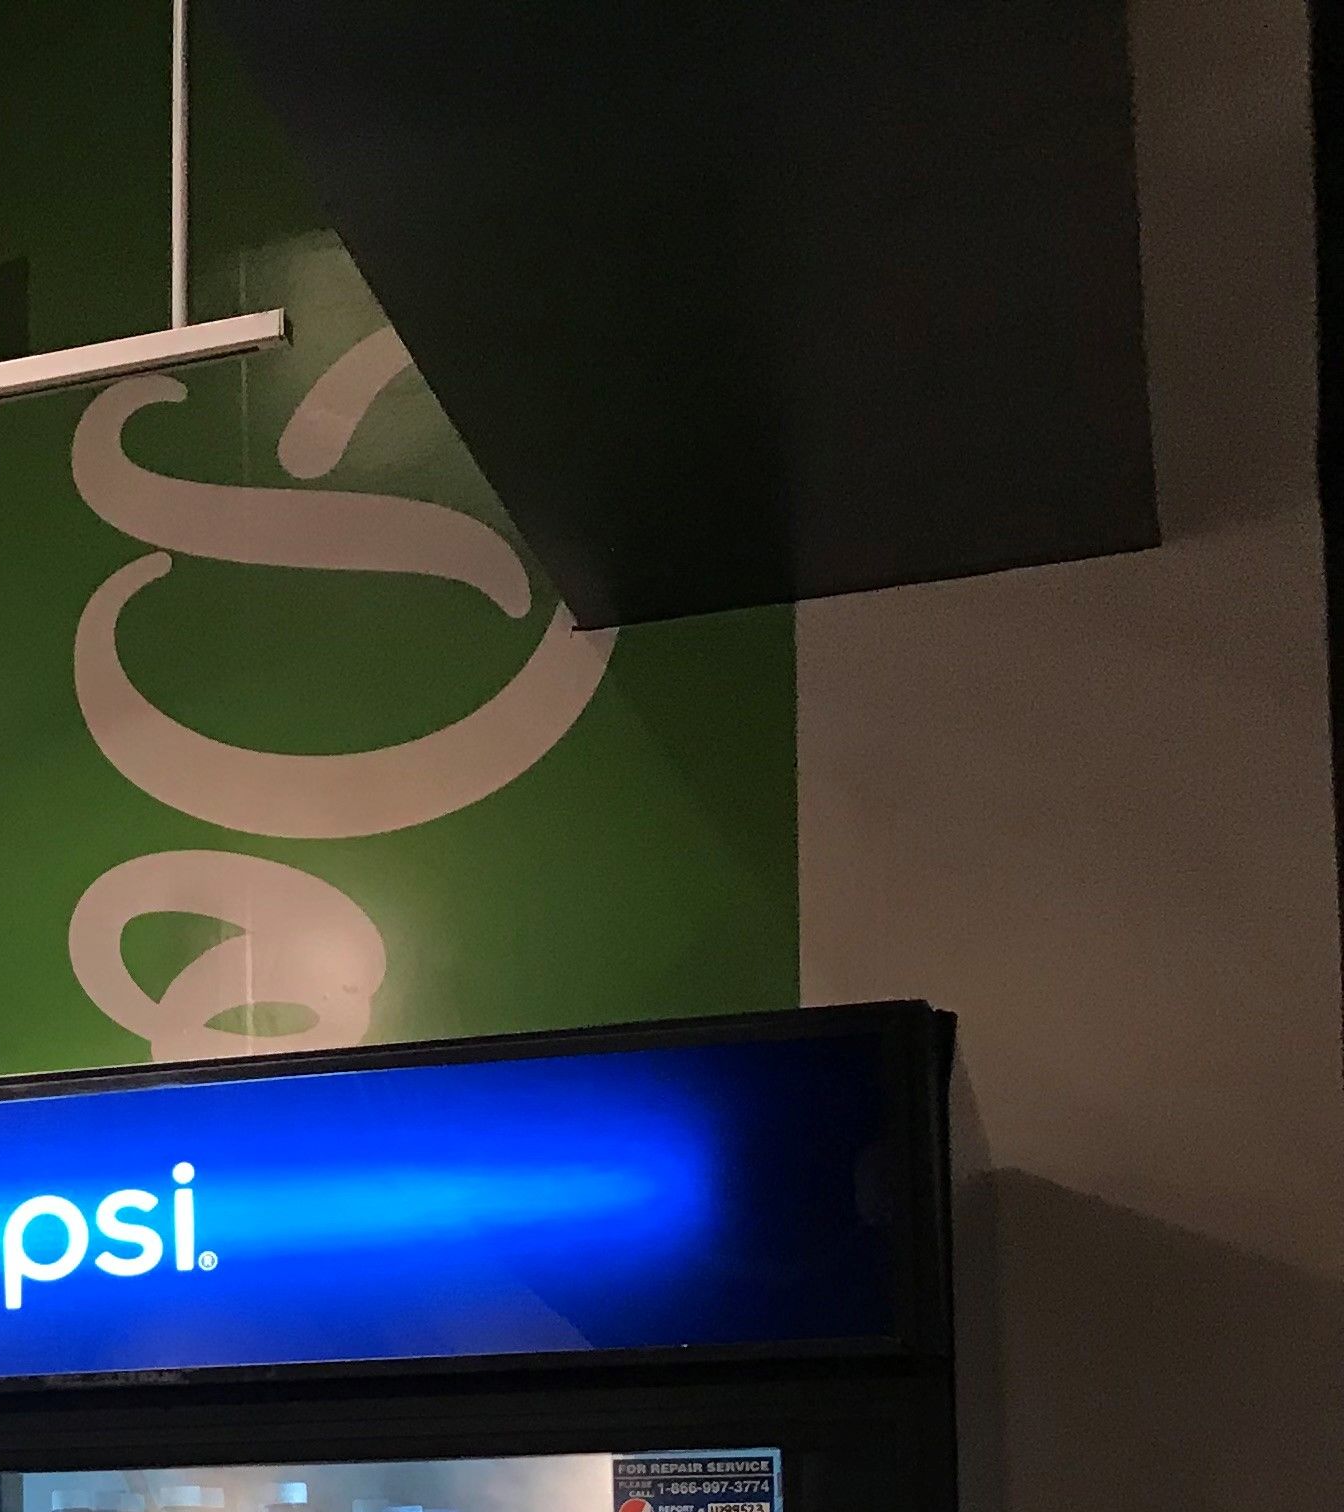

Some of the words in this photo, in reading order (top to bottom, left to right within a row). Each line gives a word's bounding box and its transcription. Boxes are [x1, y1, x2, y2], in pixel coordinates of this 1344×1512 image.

[618, 1463, 647, 1475] FOR
[650, 1462, 703, 1475] REPAIR
[706, 1460, 770, 1473] SERVICE
[657, 1479, 770, 1495] 1-866-997-3774
